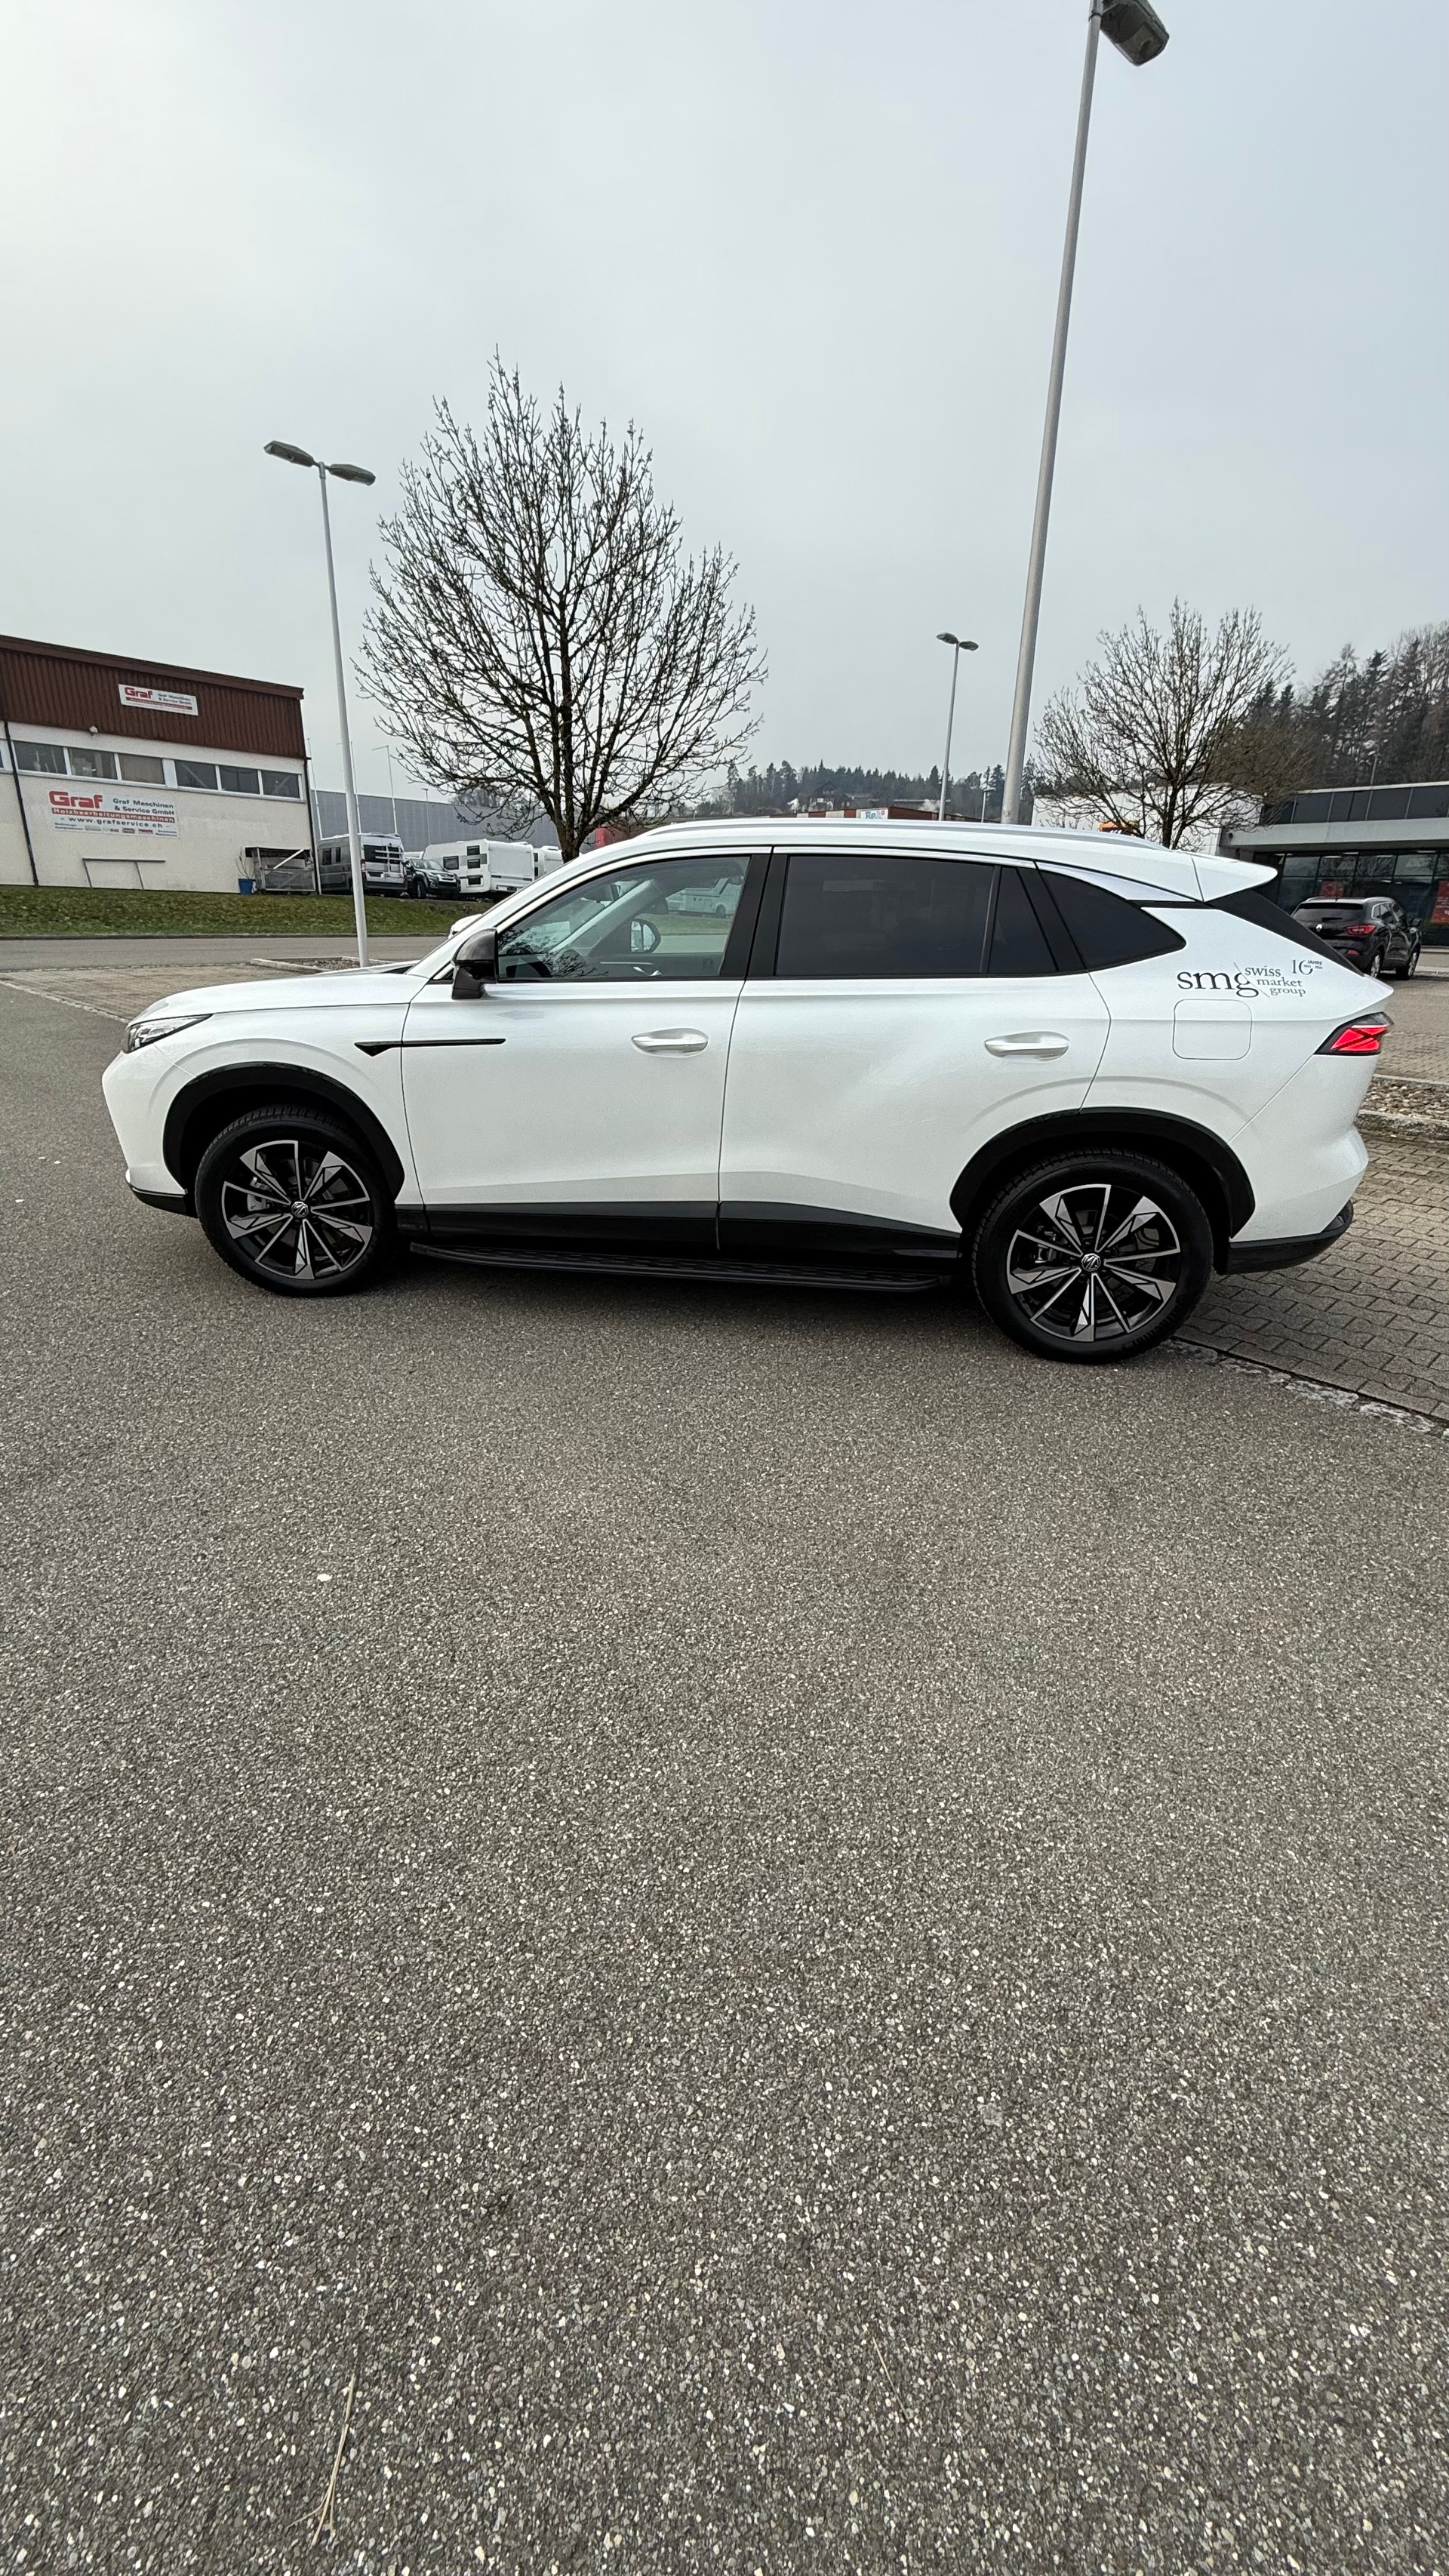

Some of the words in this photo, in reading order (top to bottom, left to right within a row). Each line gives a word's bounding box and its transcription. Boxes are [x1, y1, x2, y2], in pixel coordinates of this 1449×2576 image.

[125, 687, 152, 699] Graf
[49, 790, 103, 808] Graf
[133, 800, 174, 808] Maschinen
[54, 808, 174, 823] Holzbearbeitungsmaschinen
[68, 817, 163, 828] www.grafservice.ch
[1244, 965, 1281, 977] swiss
[1177, 971, 1260, 998] smg
[1257, 977, 1303, 986] market
[1269, 987, 1306, 997] group
